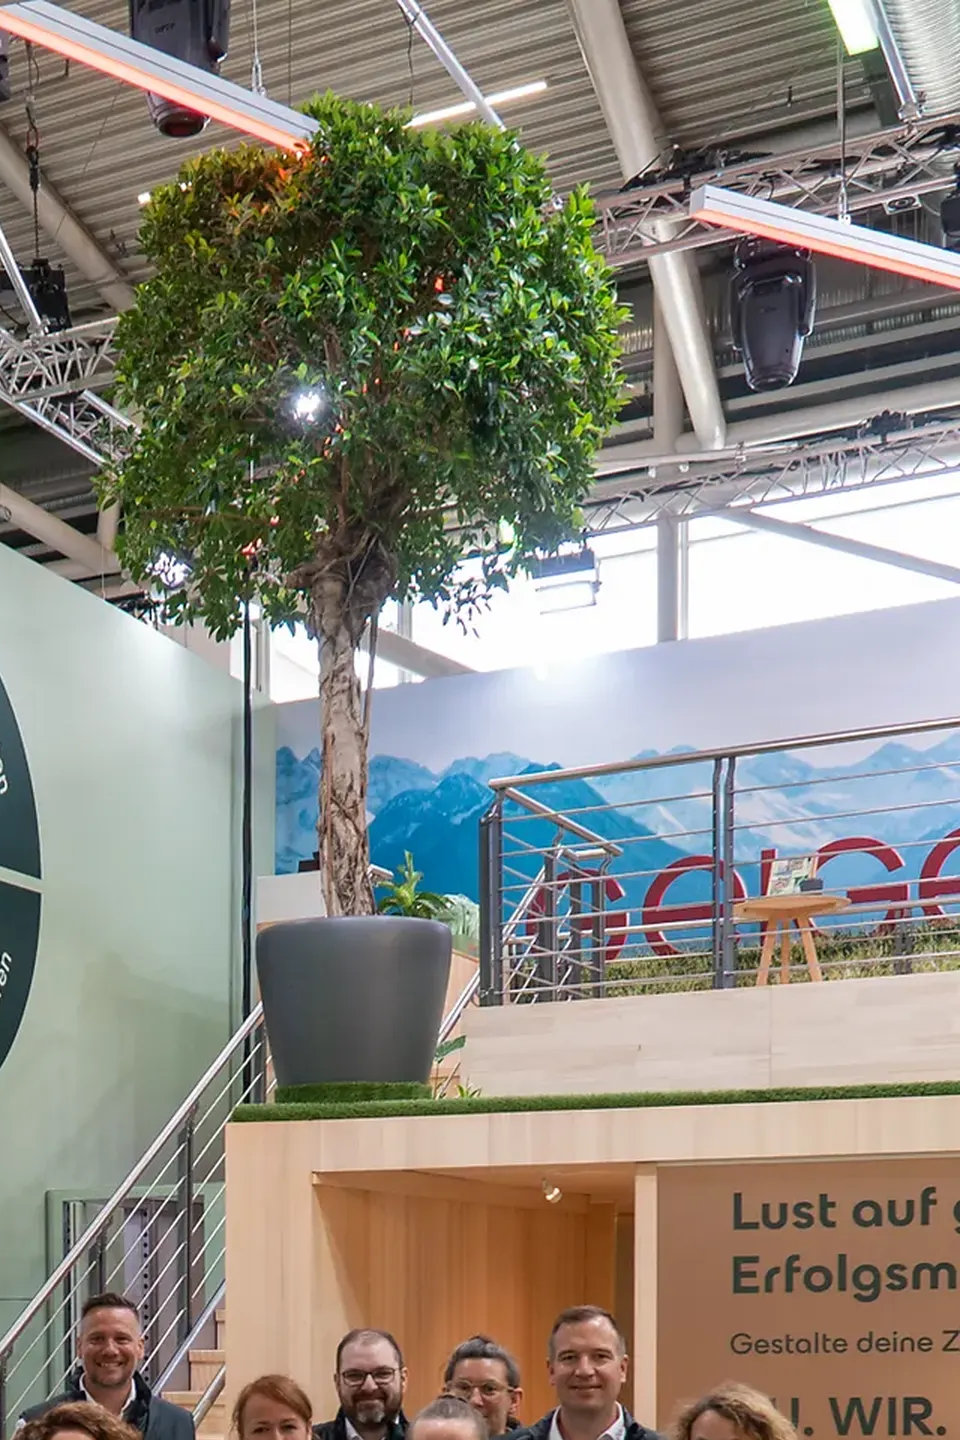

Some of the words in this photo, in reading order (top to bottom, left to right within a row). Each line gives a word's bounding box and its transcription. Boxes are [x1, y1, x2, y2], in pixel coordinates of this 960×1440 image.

[733, 1192, 837, 1230] Lust
[852, 1186, 937, 1228] auf
[732, 1254, 957, 1303] Erfolgsm
[730, 1332, 848, 1354] Gestalte
[856, 1331, 933, 1353] deine
[828, 1396, 947, 1436] WIR.
